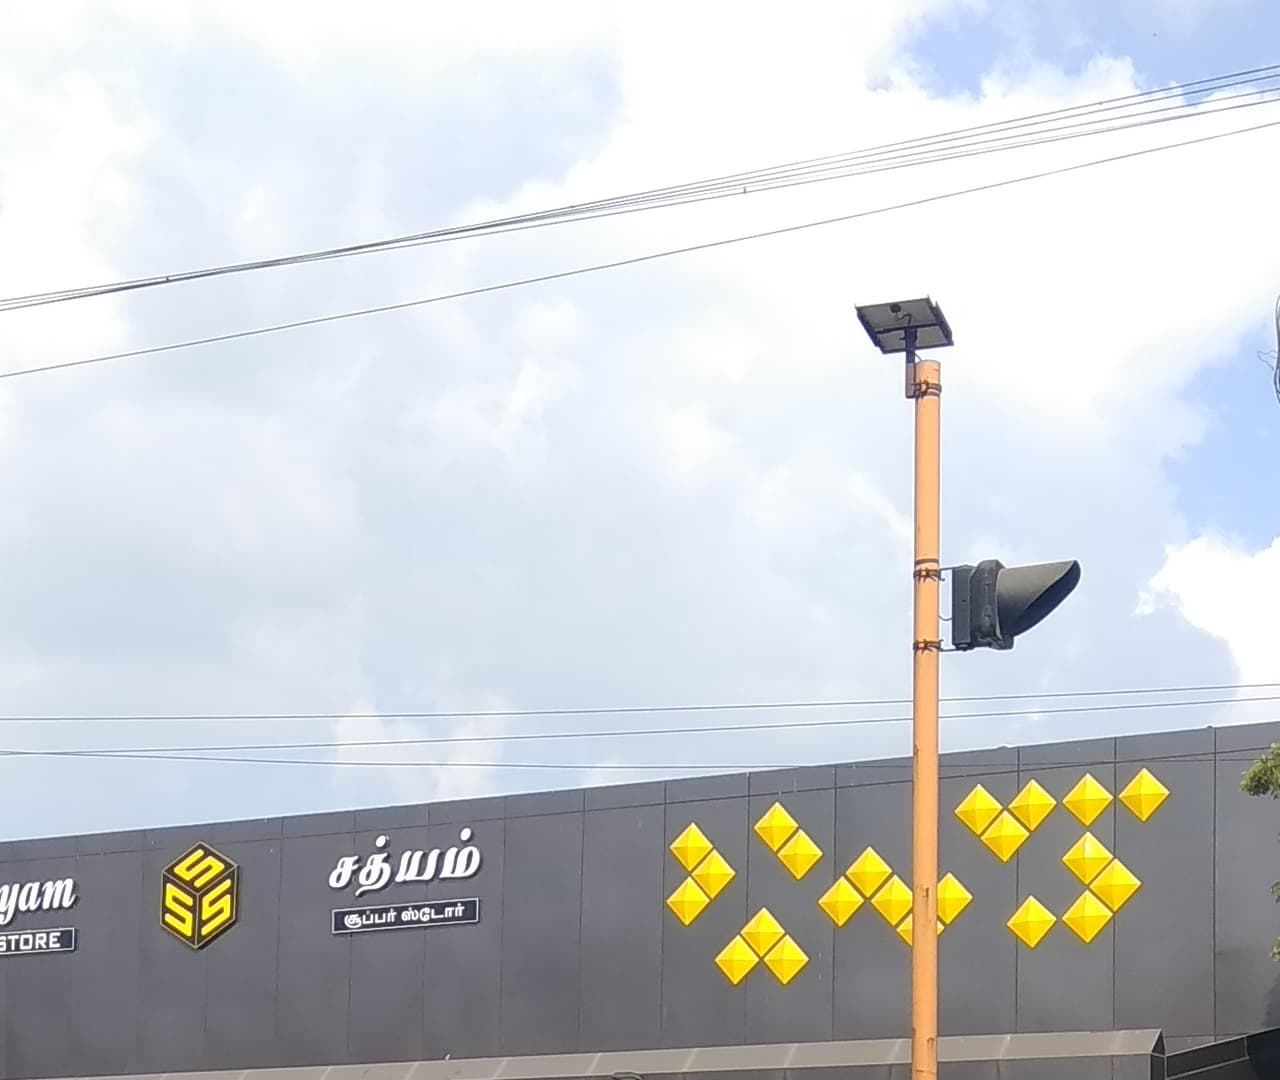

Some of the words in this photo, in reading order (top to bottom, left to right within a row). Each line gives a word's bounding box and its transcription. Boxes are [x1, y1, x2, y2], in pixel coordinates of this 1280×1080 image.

[328, 827, 481, 897] சத்யம்
[343, 907, 398, 929] சூப்பர்
[401, 902, 465, 922] ஸ்டோர்
